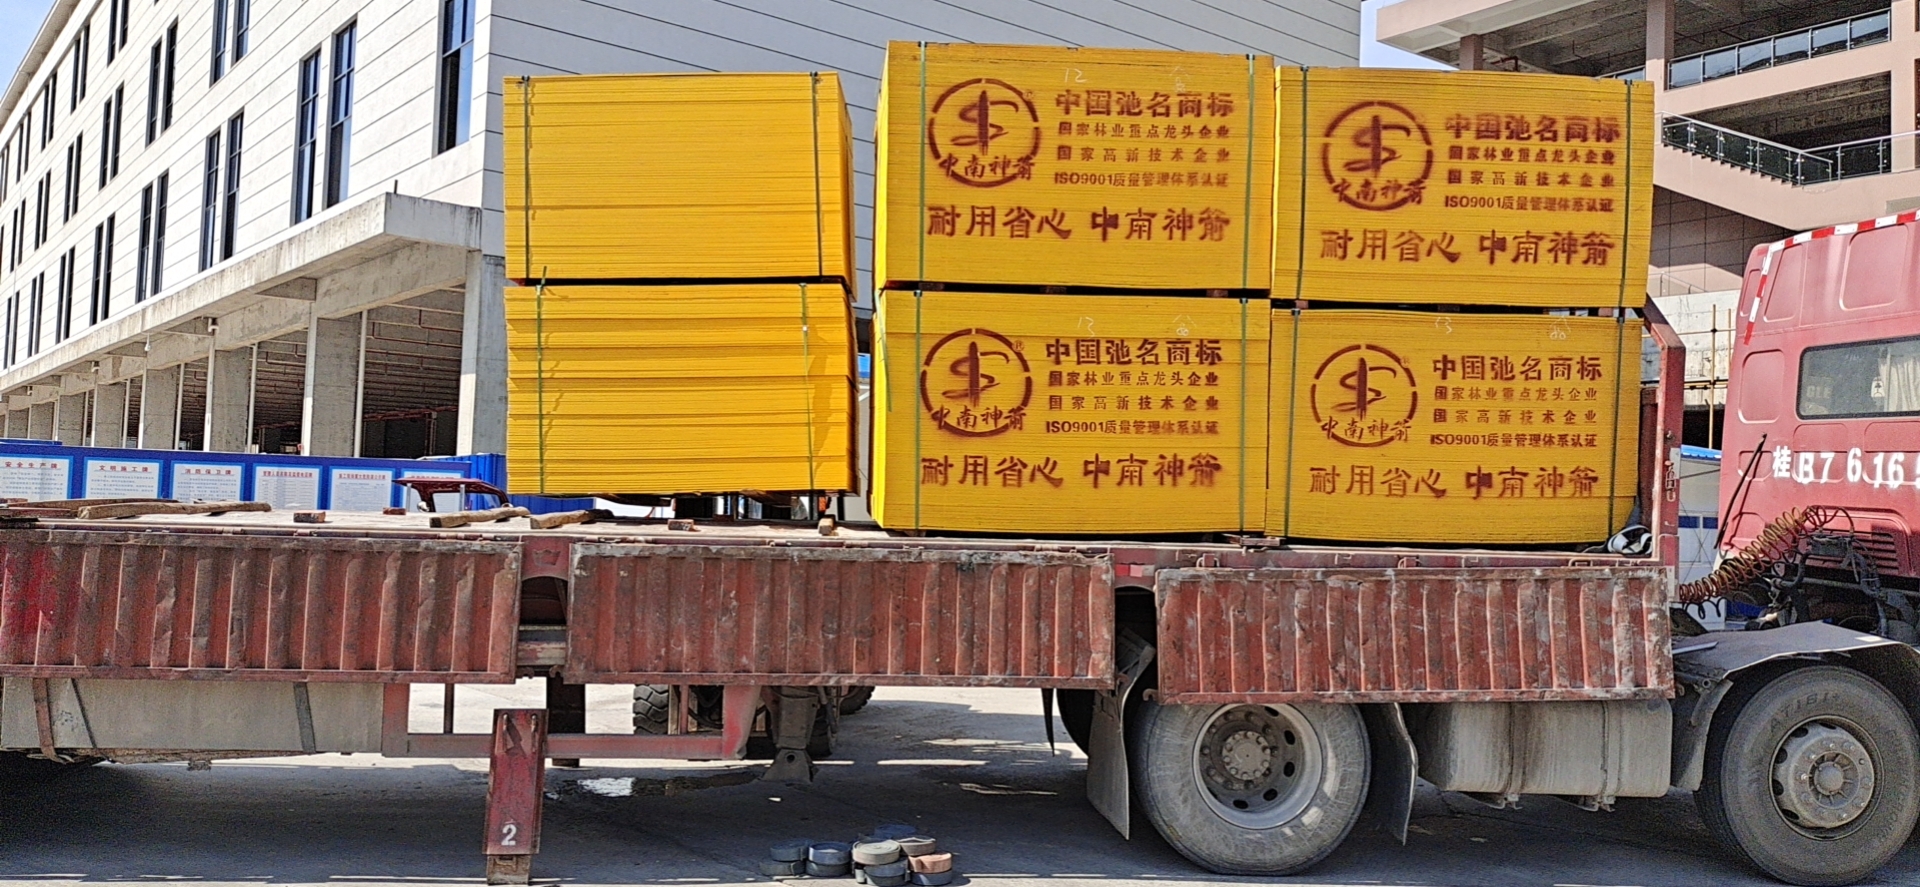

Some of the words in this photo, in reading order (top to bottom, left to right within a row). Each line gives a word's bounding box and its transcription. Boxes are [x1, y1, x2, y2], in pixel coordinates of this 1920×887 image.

[1058, 122, 1229, 138] 国家林业重点龙头企业
[1057, 145, 1229, 162] 国家高新技术企业
[1449, 145, 1615, 165] 国家林业重点龙头企业
[1447, 169, 1614, 187] 国家高新技术企业
[927, 205, 1072, 239] 耐用省心
[1091, 206, 1230, 242] 中南神箭
[1321, 229, 1461, 263] 耐用省心
[1479, 230, 1615, 266] 中南神箭
[1048, 371, 1218, 387] 国家林业重点龙头企业
[1435, 386, 1597, 401] 国家林业重点龙头企业
[1049, 395, 1218, 411] 国家高新技术企业
[1434, 408, 1596, 424] 国家高新技术企业
[1046, 420, 1218, 434] ISO9001质量管理体系认证
[1430, 433, 1597, 447] ISO9001质量管理体系认证
[921, 455, 1063, 488] 耐用省心
[1083, 453, 1222, 489] 中南神箭
[1310, 465, 1447, 499] 耐用省心
[1465, 466, 1599, 500] 中南神箭
[501, 824, 517, 846] 2
